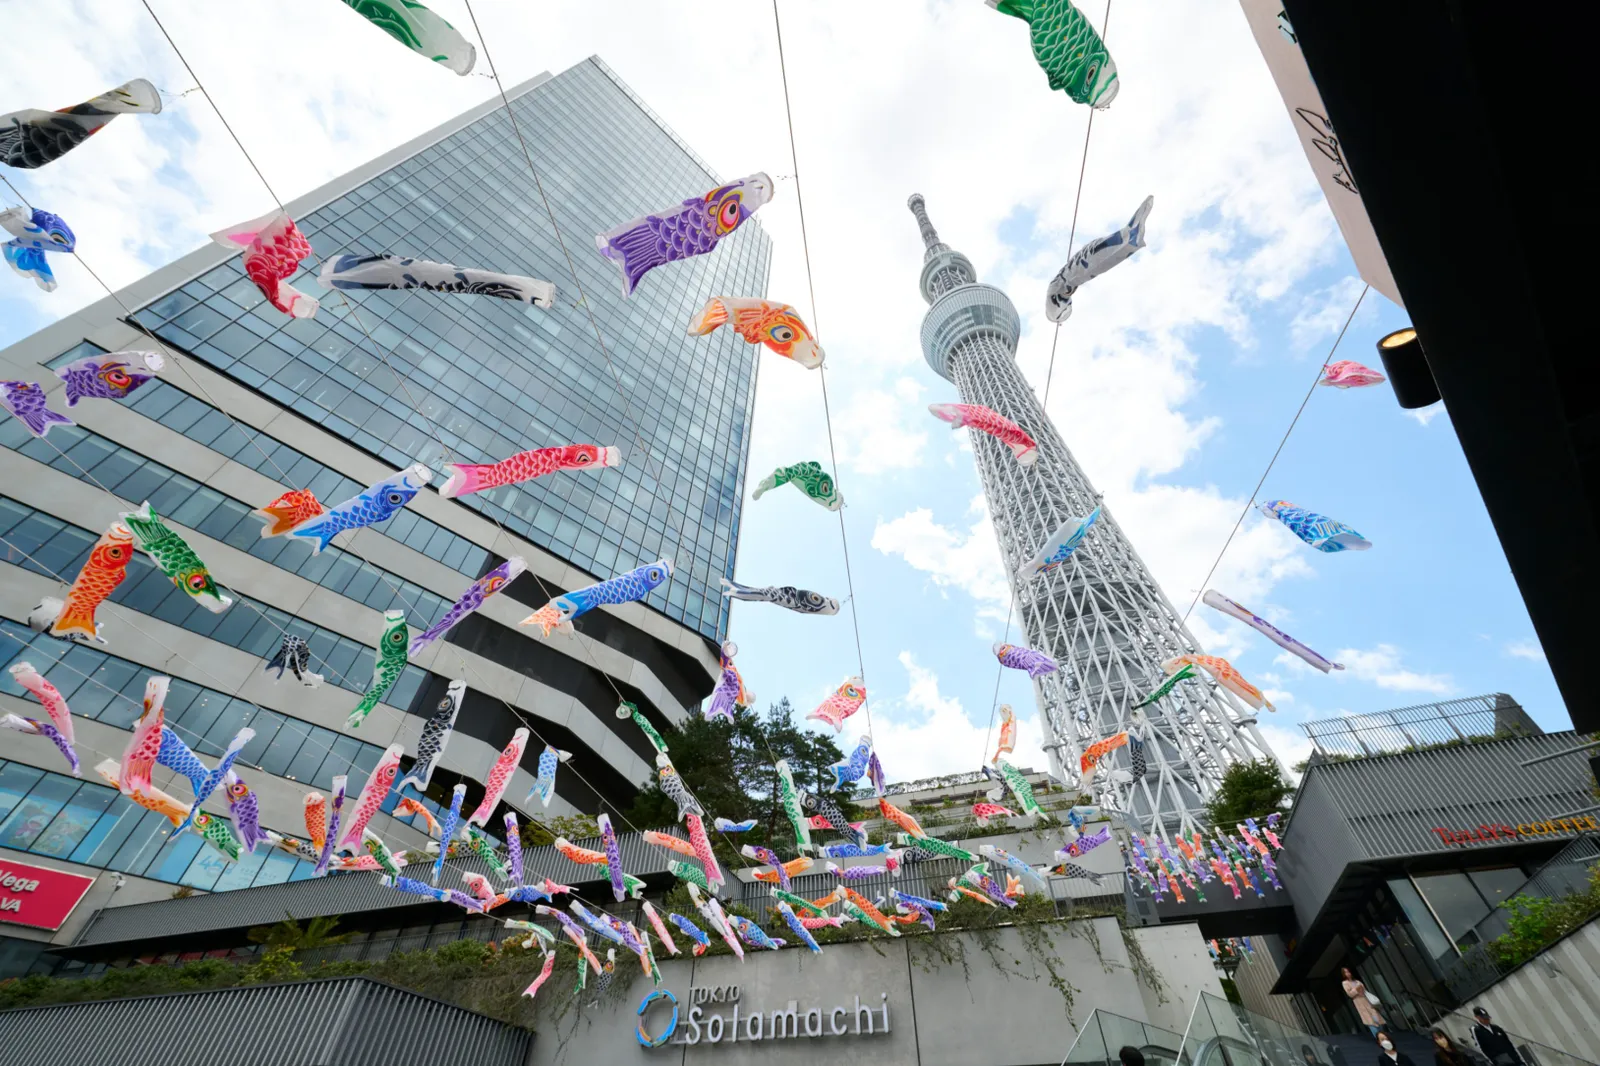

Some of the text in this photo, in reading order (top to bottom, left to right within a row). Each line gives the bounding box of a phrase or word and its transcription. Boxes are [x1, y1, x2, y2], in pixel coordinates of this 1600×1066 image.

[1517, 815, 1600, 837] COFFEE
[690, 984, 741, 1004] TOKYO
[685, 992, 890, 1045] Solamachi
